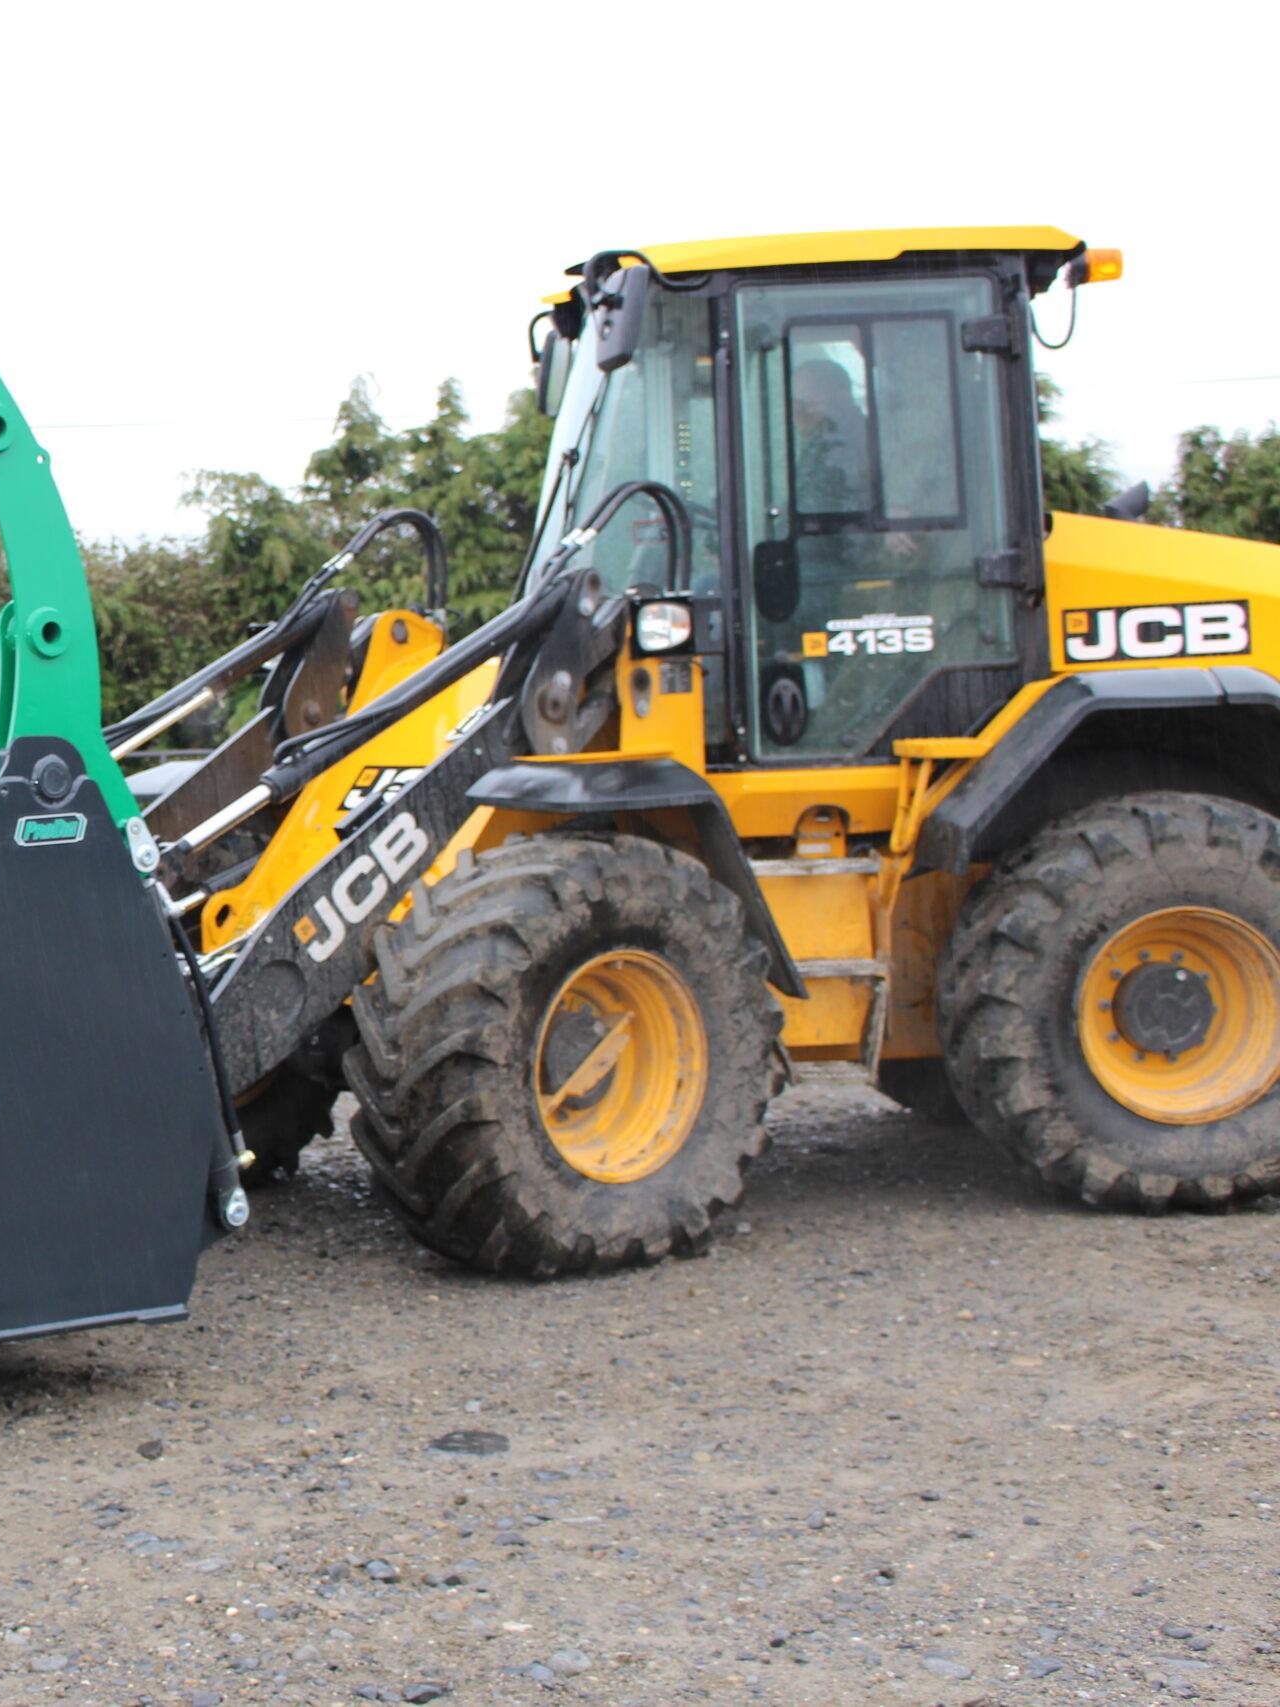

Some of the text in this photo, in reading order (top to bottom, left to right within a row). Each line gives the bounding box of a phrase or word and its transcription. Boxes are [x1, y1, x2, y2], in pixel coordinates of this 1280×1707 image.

[827, 627, 935, 656] 413S
[1066, 603, 1249, 661] JCB
[307, 811, 429, 963] JCB
